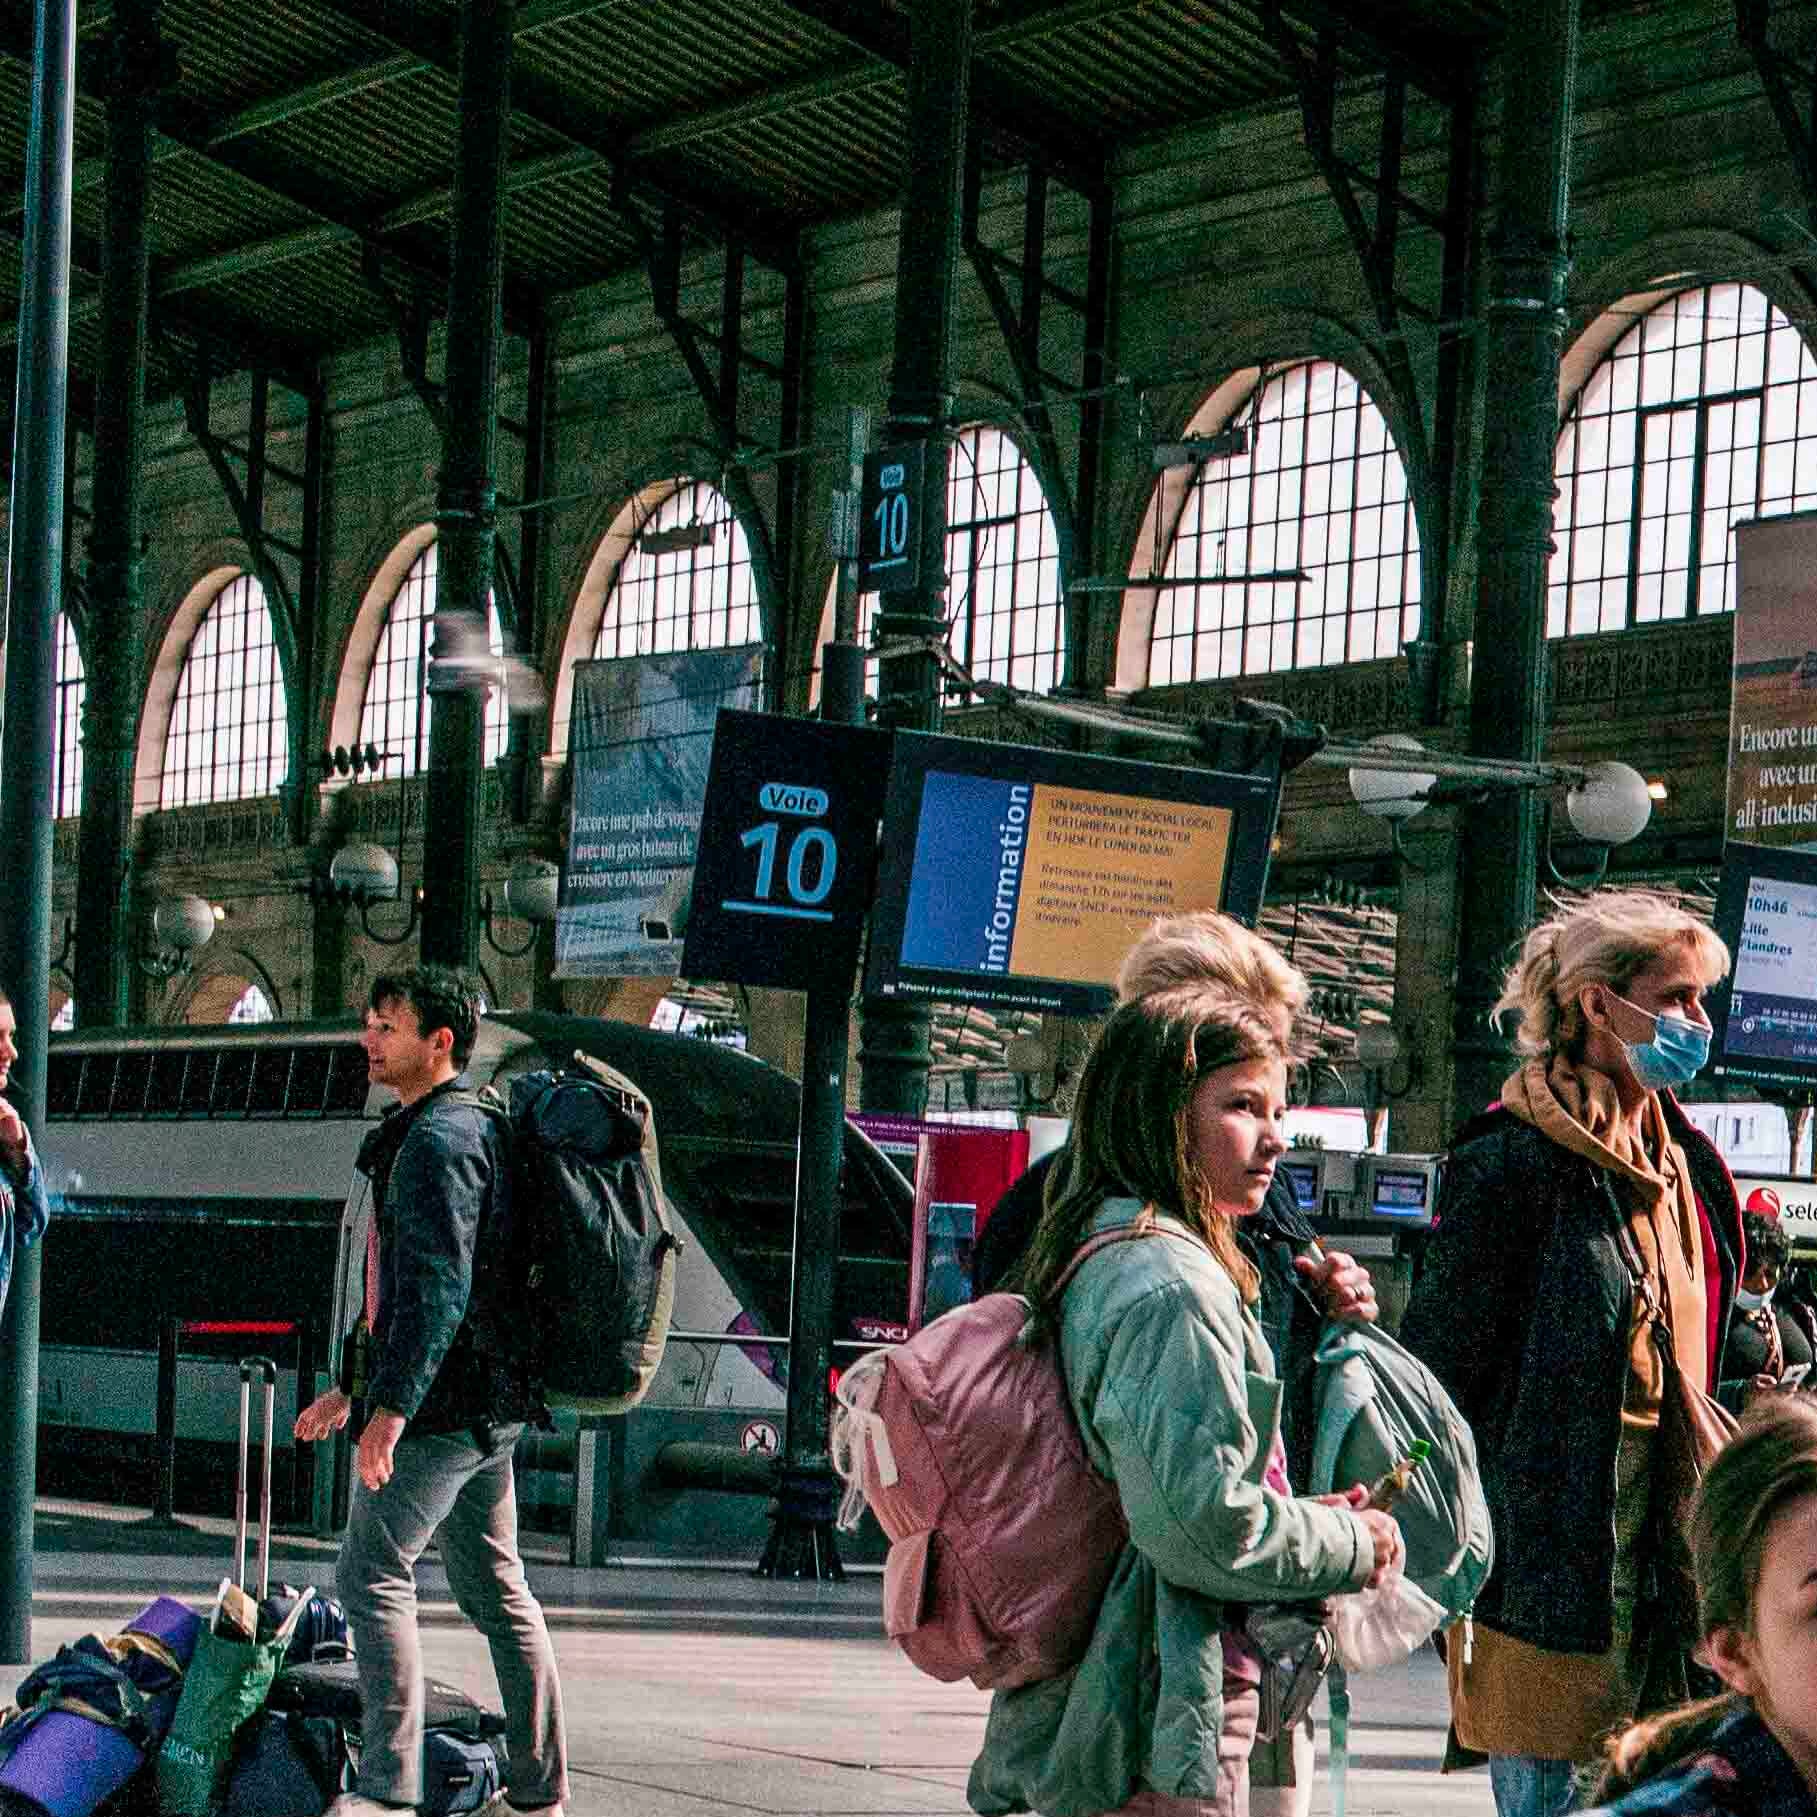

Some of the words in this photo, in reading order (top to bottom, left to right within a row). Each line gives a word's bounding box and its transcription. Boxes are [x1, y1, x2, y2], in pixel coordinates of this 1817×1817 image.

[875, 493, 908, 558] 10
[1739, 723, 1797, 753] Encore
[1758, 762, 1797, 789] avec
[769, 787, 820, 812] Voie
[741, 821, 837, 904] 10
[980, 785, 1030, 972] information
[1749, 897, 1788, 915] 10h46
